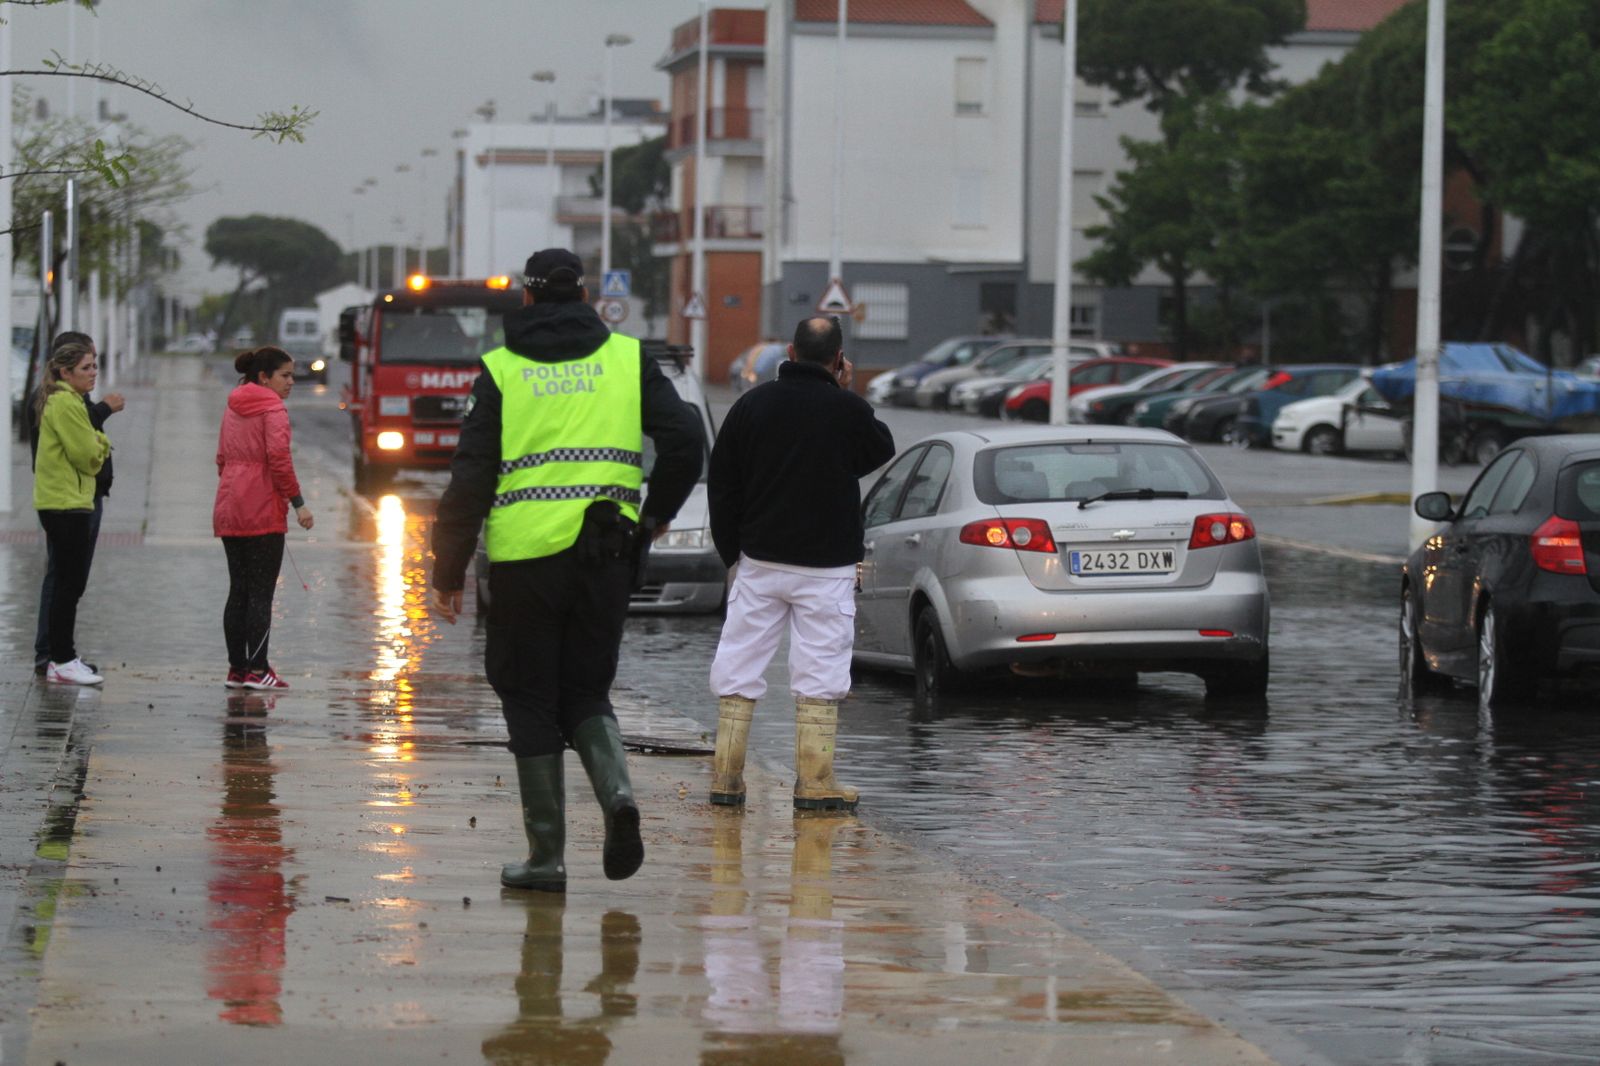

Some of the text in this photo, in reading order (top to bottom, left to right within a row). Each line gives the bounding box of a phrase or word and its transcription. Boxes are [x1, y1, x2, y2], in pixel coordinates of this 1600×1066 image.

[522, 363, 604, 382] POLICIA
[532, 379, 596, 397] LOCAL
[1082, 551, 1173, 571] 2432 DXW
